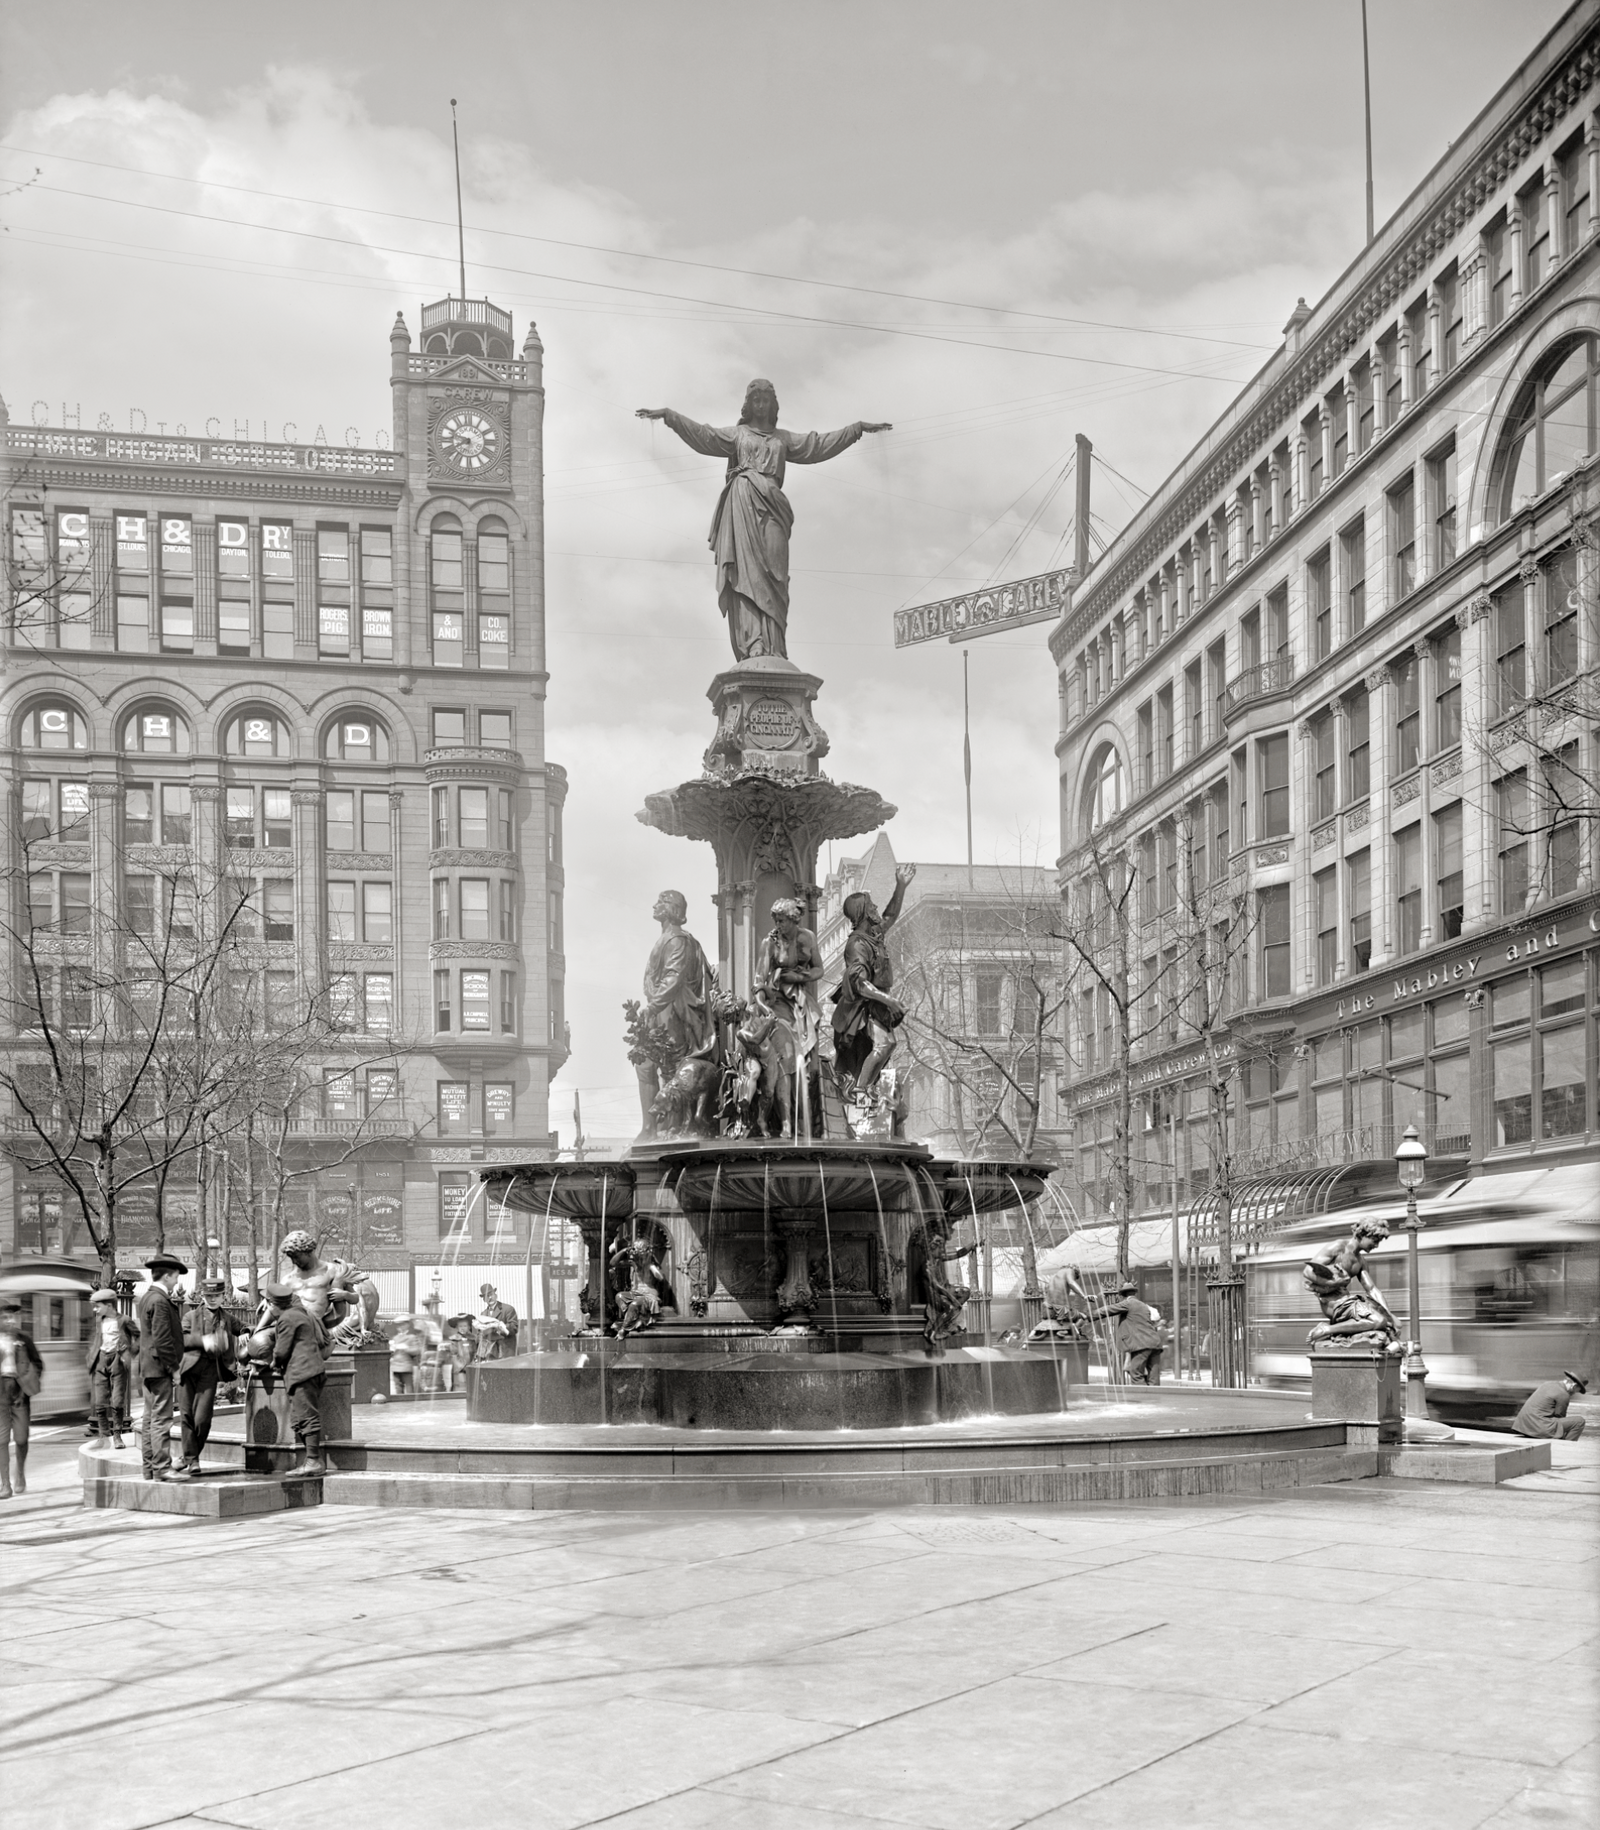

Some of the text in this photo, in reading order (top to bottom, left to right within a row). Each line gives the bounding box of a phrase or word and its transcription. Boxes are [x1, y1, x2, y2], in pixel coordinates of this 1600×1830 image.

[458, 368, 478, 380] 1891
[444, 386, 493, 401] CAREW
[206, 417, 390, 450] CHICAGO
[48, 434, 200, 464] MICHIGAN
[282, 446, 378, 475] LOUIS
[60, 514, 87, 536] C
[118, 516, 146, 540] H
[164, 519, 190, 544] &
[220, 522, 246, 546] D
[364, 610, 391, 622] BROWN
[444, 615, 452, 626] &
[894, 593, 980, 647] MABLEY
[976, 602, 994, 622] &
[324, 622, 343, 633] PIG
[438, 627, 458, 639] AND
[42, 711, 369, 744] C H & D
[750, 714, 783, 726] PEOPLE
[750, 725, 794, 736] CINCINNATI
[1335, 994, 1375, 1020] The
[1392, 955, 1482, 1001] Mabley
[1506, 924, 1559, 962] and
[364, 1196, 402, 1209] BERKSHIRE
